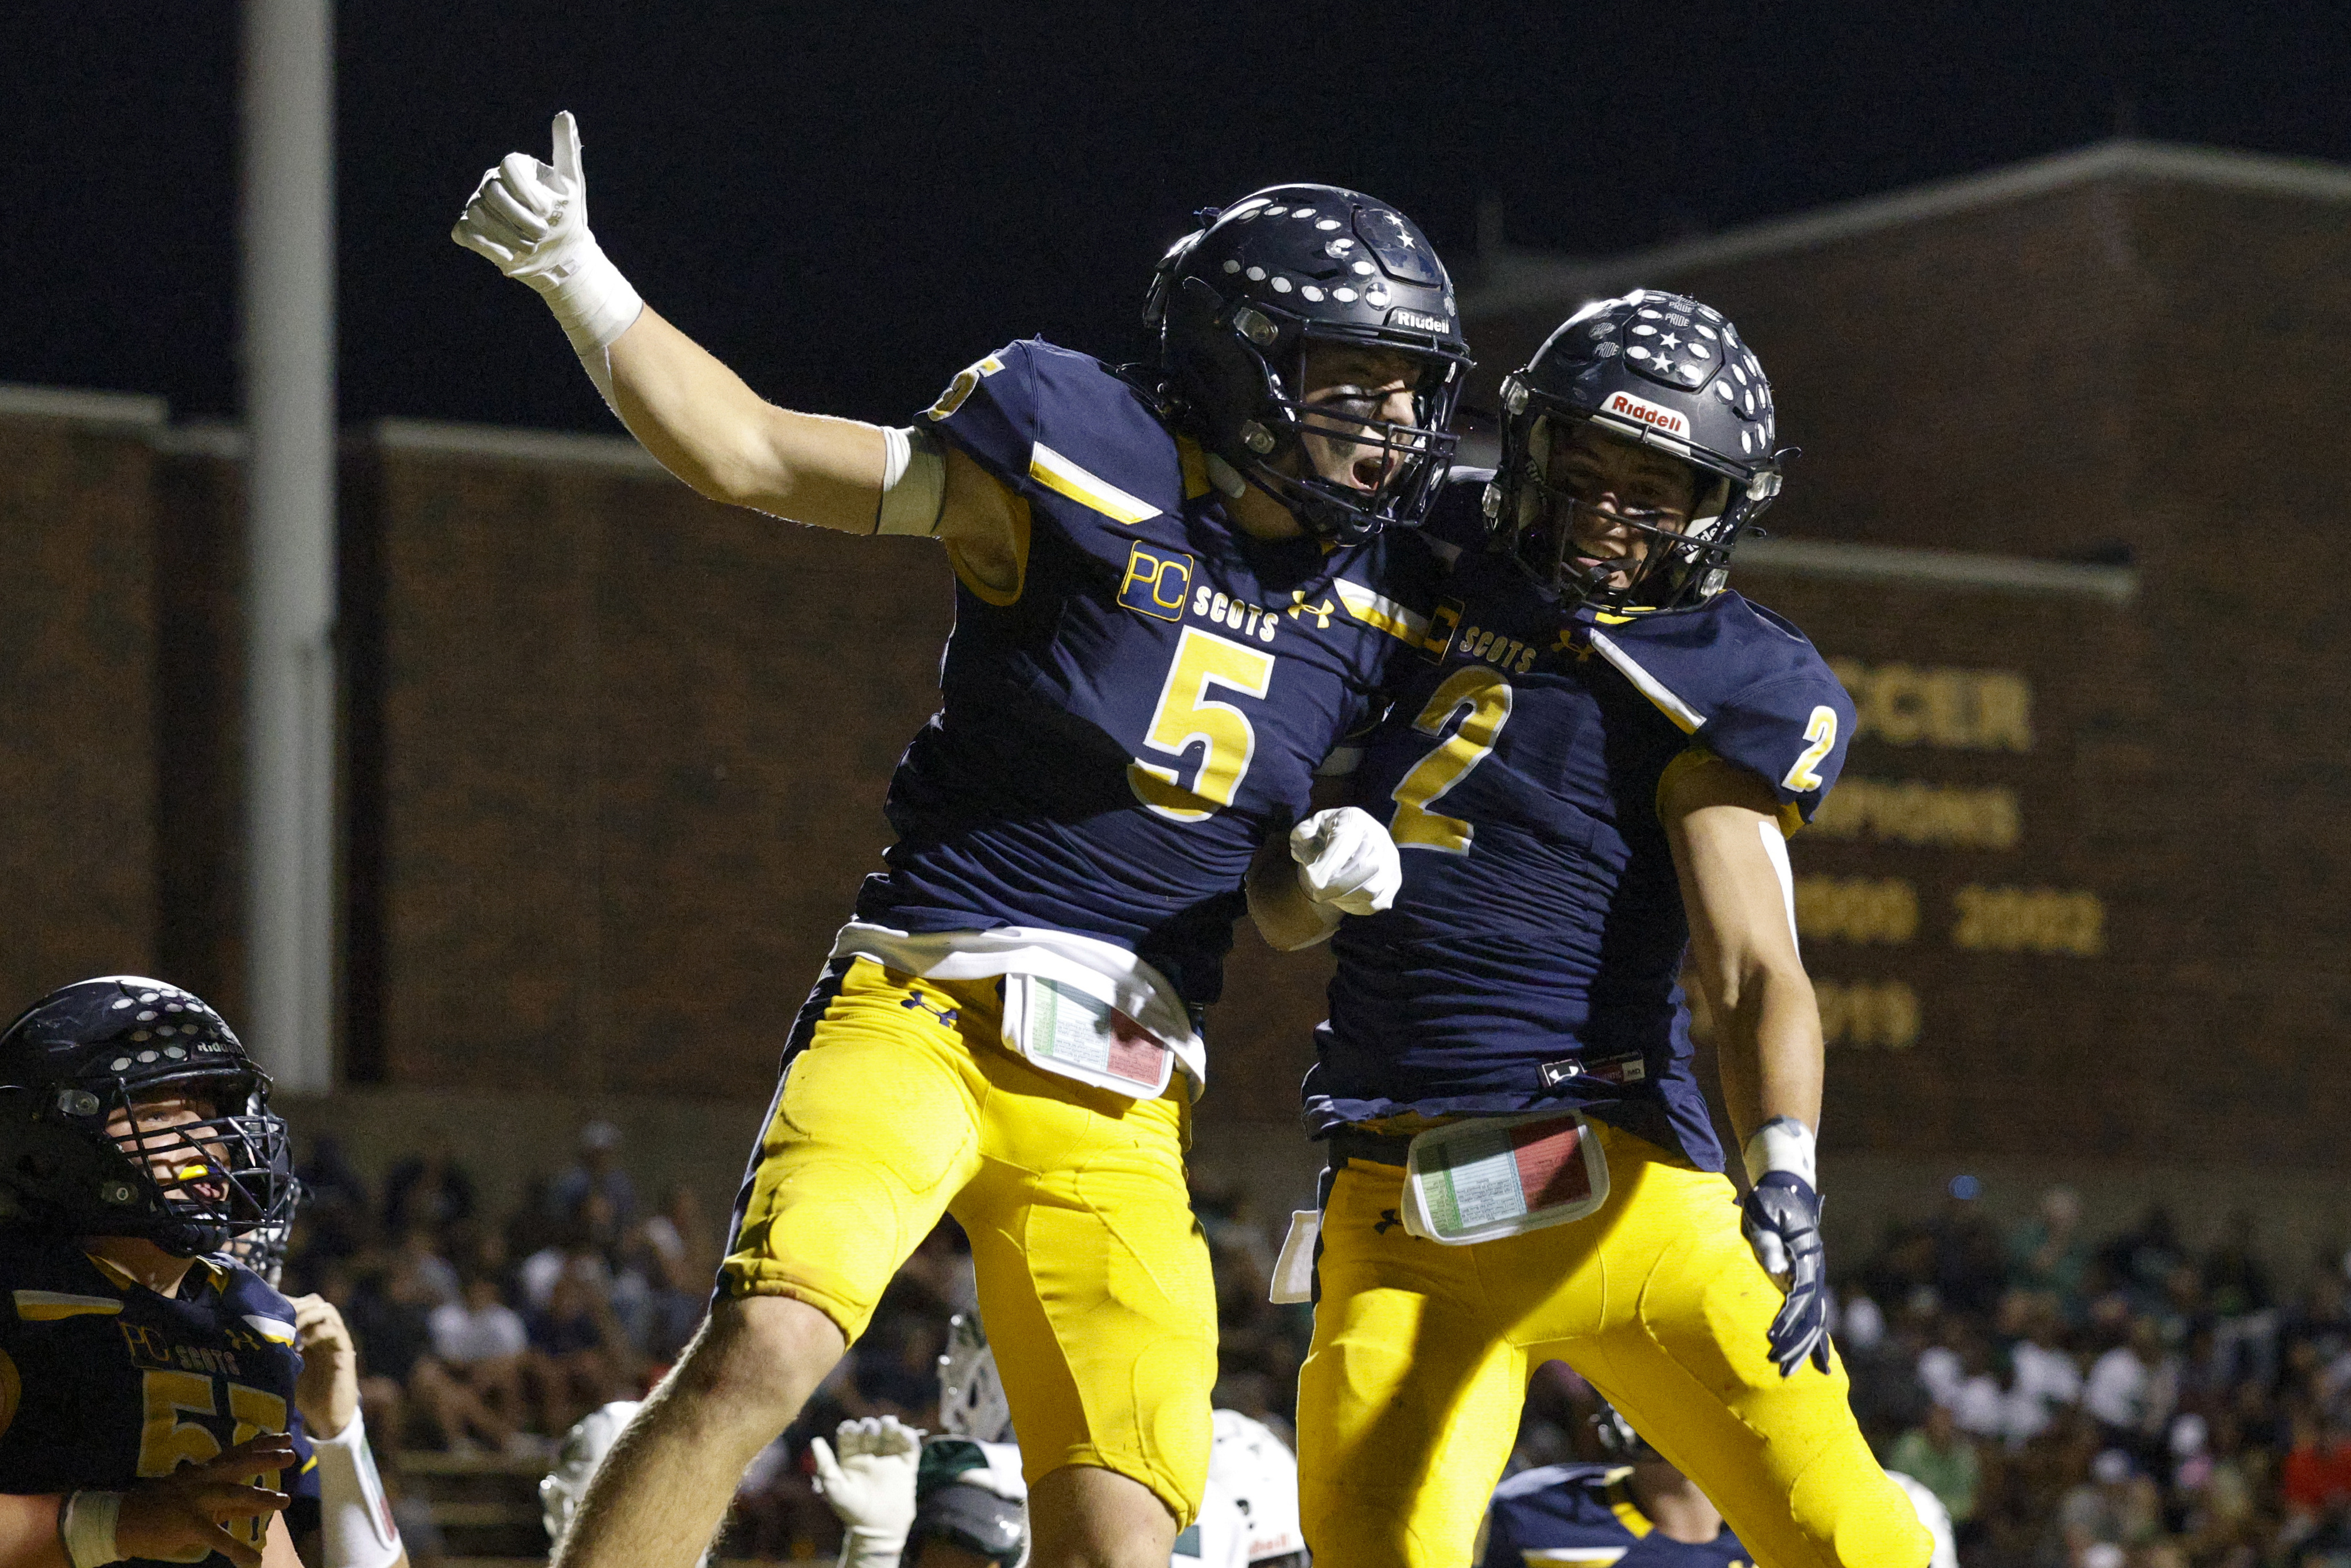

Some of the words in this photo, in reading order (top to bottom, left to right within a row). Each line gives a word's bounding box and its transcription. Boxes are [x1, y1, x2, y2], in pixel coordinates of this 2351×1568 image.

[1398, 310, 1449, 334] Riddell
[1665, 312, 1690, 327] PRIDE
[1594, 341, 1620, 358] PRIDE
[1611, 395, 1682, 432] Riddell
[1121, 550, 1188, 610] PC
[1193, 585, 1279, 642] SCOTS
[1459, 626, 1537, 674] SCOTS
[1127, 624, 1276, 822] 5
[1780, 705, 1837, 793] 2
[1388, 664, 1512, 857] 2
